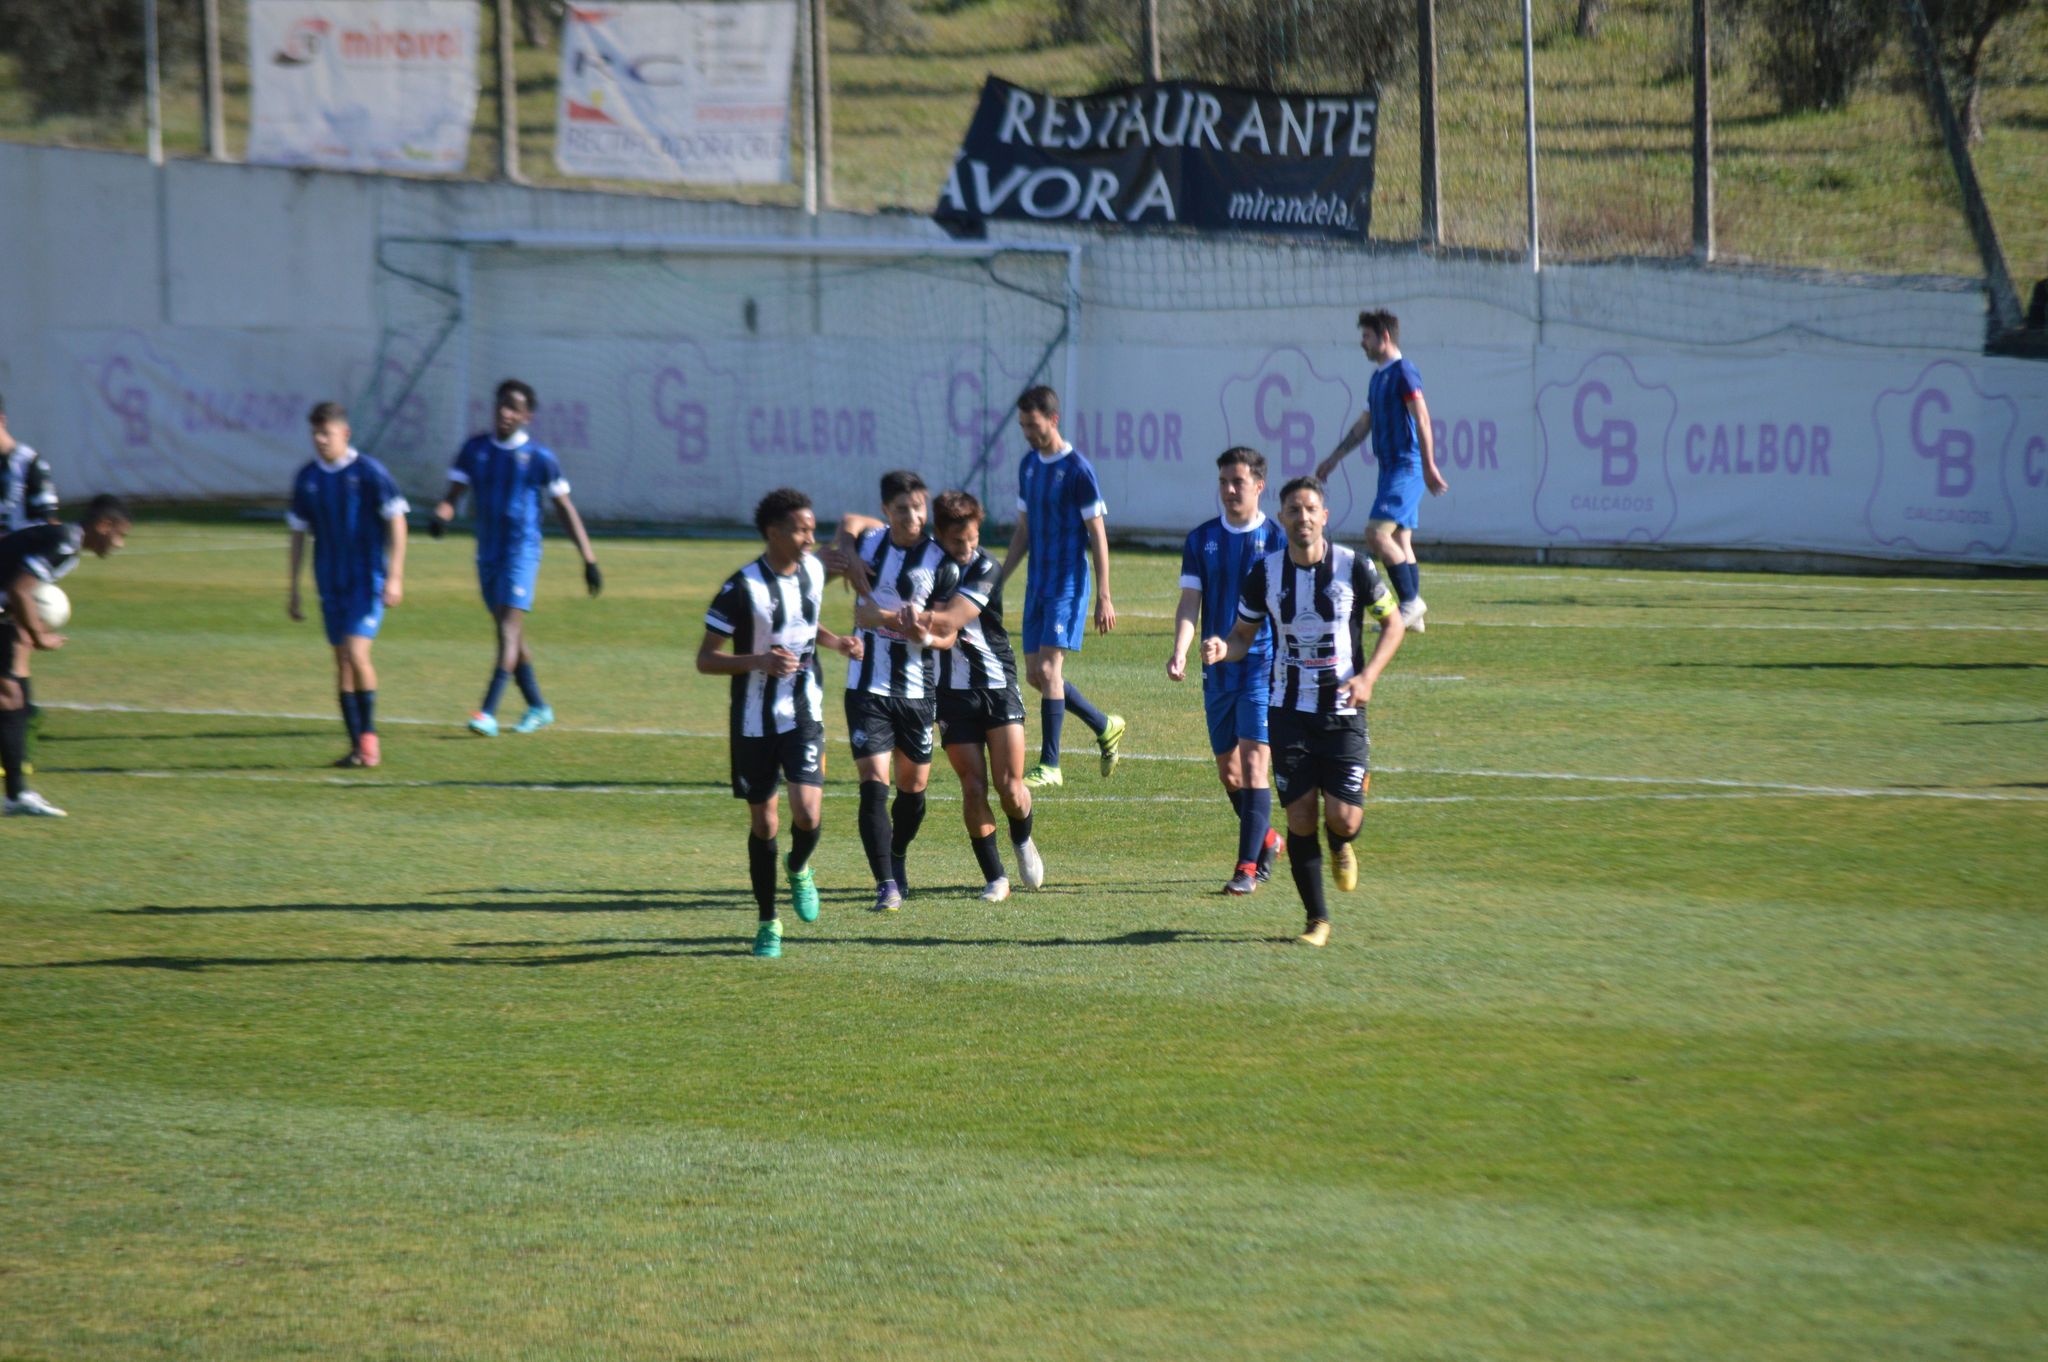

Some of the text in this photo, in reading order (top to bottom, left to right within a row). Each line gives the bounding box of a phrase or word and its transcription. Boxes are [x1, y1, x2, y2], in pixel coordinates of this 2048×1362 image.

[999, 88, 1377, 157] RESTAURANTE
[1228, 187, 1347, 226] mirandela
[746, 404, 877, 458] CALBOR
[1254, 373, 1315, 477] CB
[1572, 379, 1638, 487] CB
[1685, 422, 1832, 477] CALBOR
[1910, 388, 1976, 497] CB
